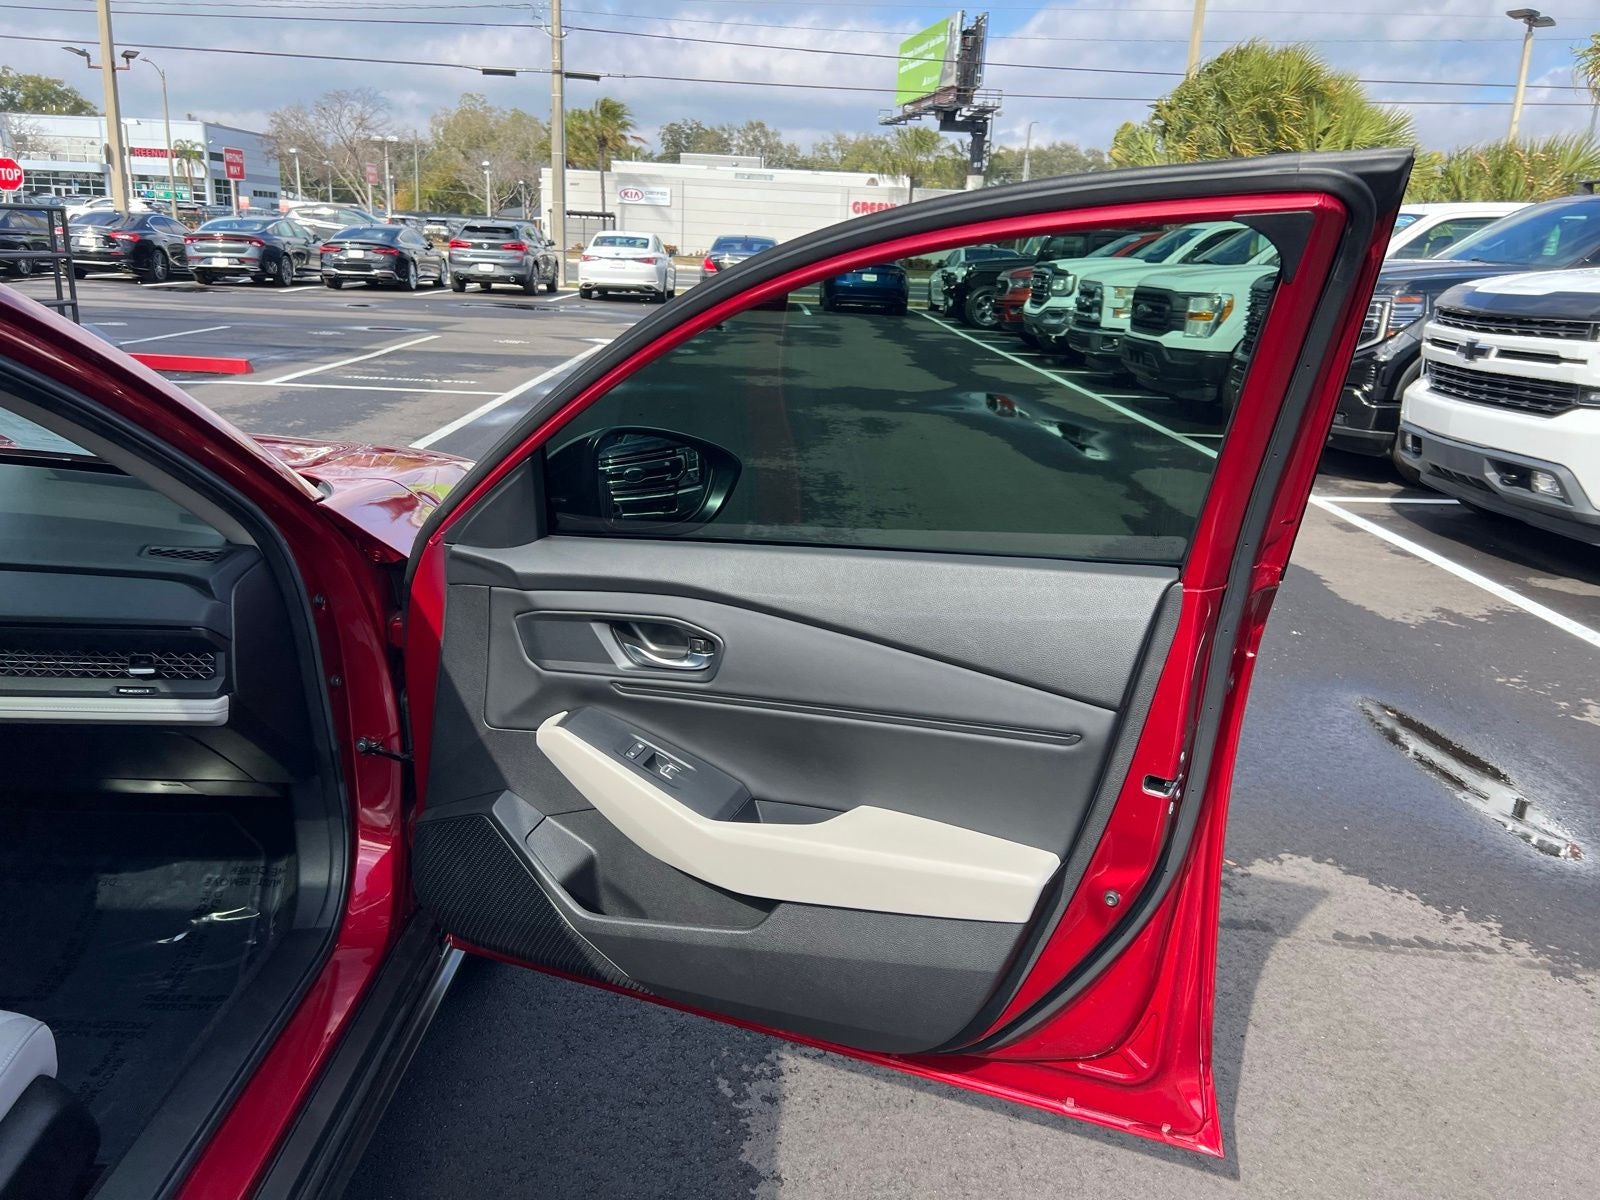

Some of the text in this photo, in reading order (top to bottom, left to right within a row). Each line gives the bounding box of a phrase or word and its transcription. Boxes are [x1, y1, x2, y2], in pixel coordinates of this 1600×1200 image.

[133, 148, 177, 158] REENWY
[225, 153, 243, 163] WRONG
[0, 168, 21, 181] TOP
[229, 165, 241, 176] WAY
